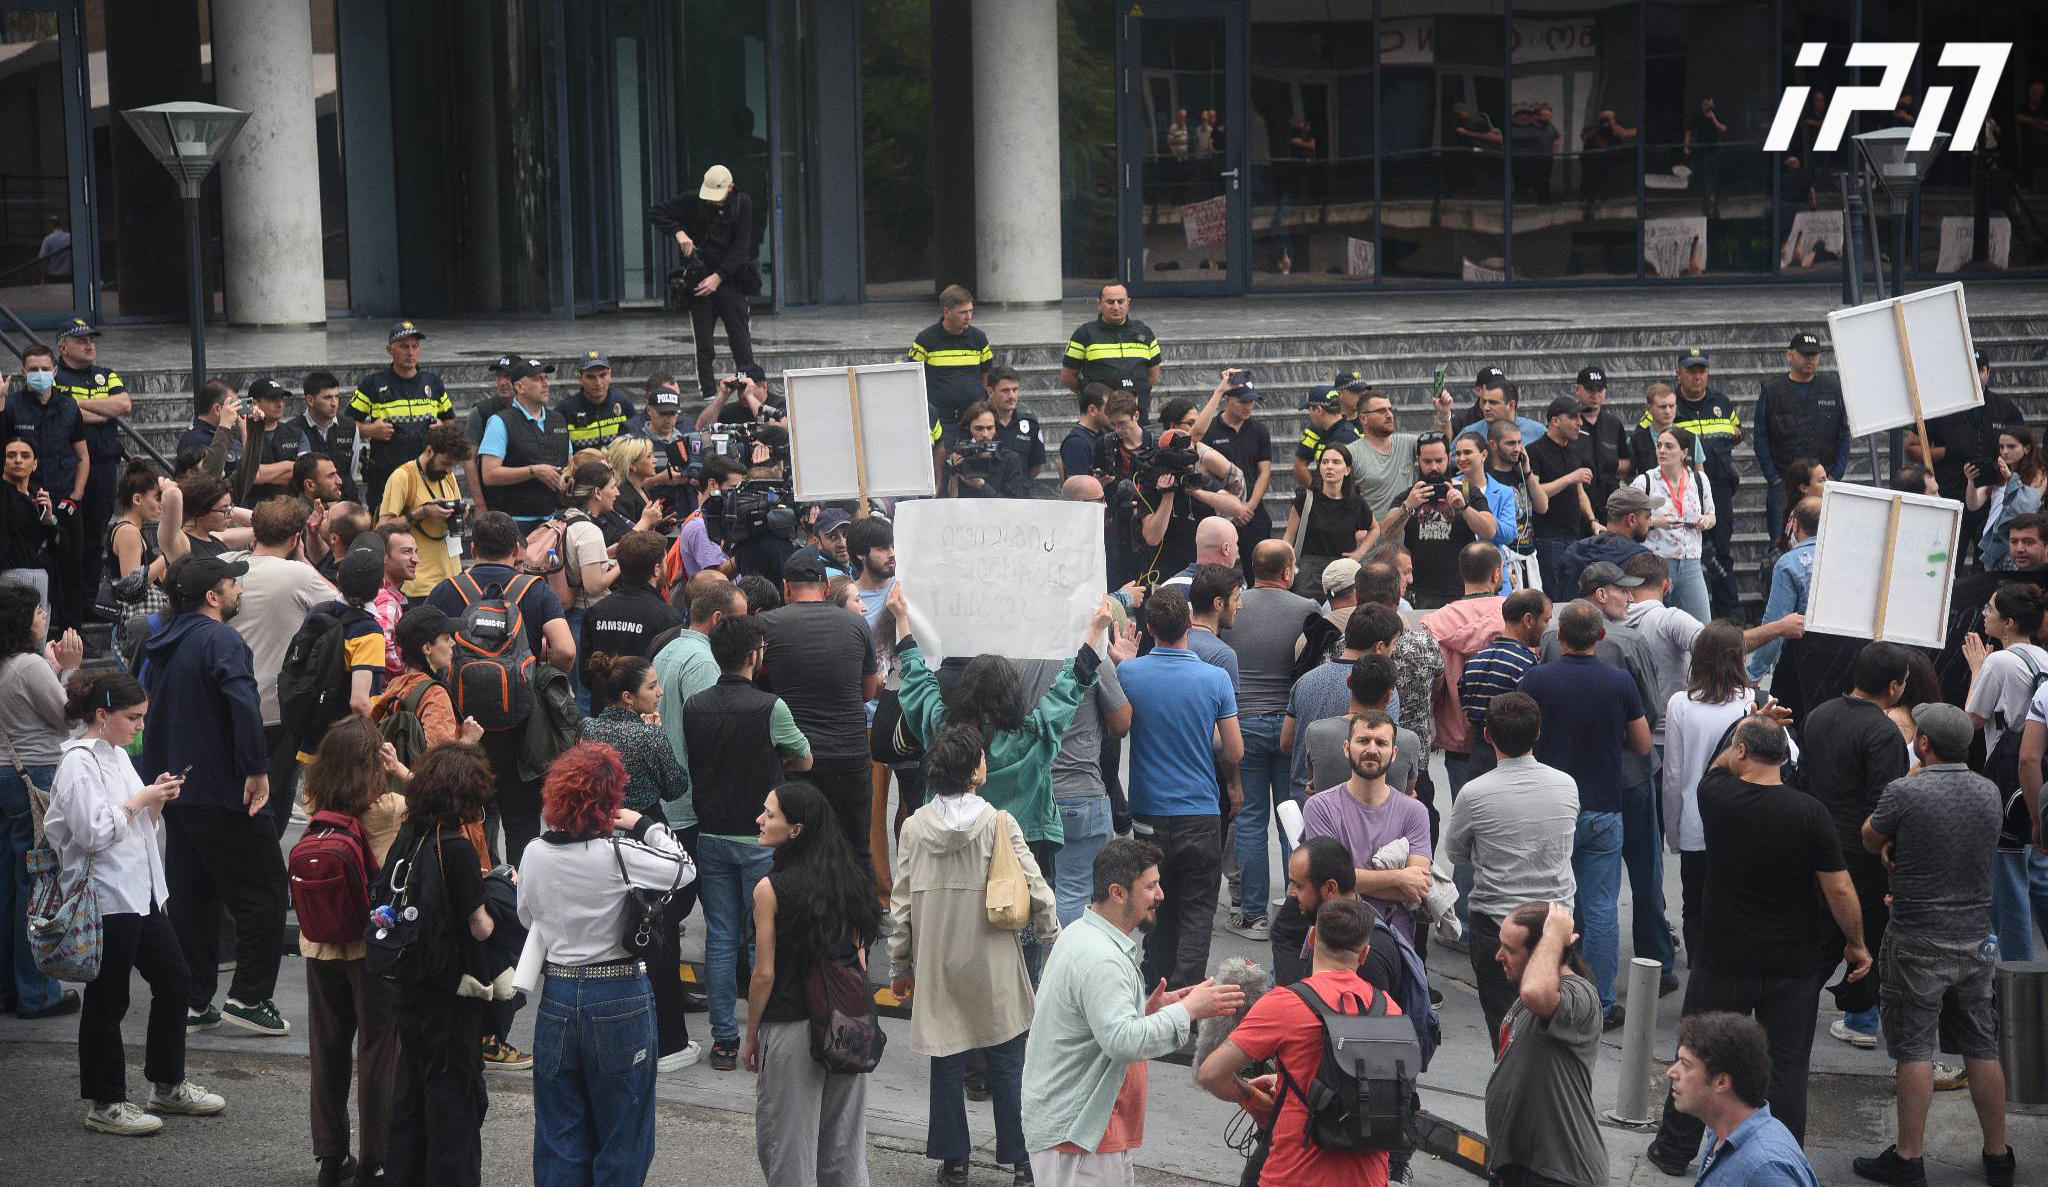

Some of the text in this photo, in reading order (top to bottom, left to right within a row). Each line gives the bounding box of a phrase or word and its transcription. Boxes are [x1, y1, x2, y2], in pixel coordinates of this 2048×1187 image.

[657, 393, 679, 404] POLICE
[1418, 529, 1451, 541] PARK
[596, 620, 643, 634] SAMSUNG
